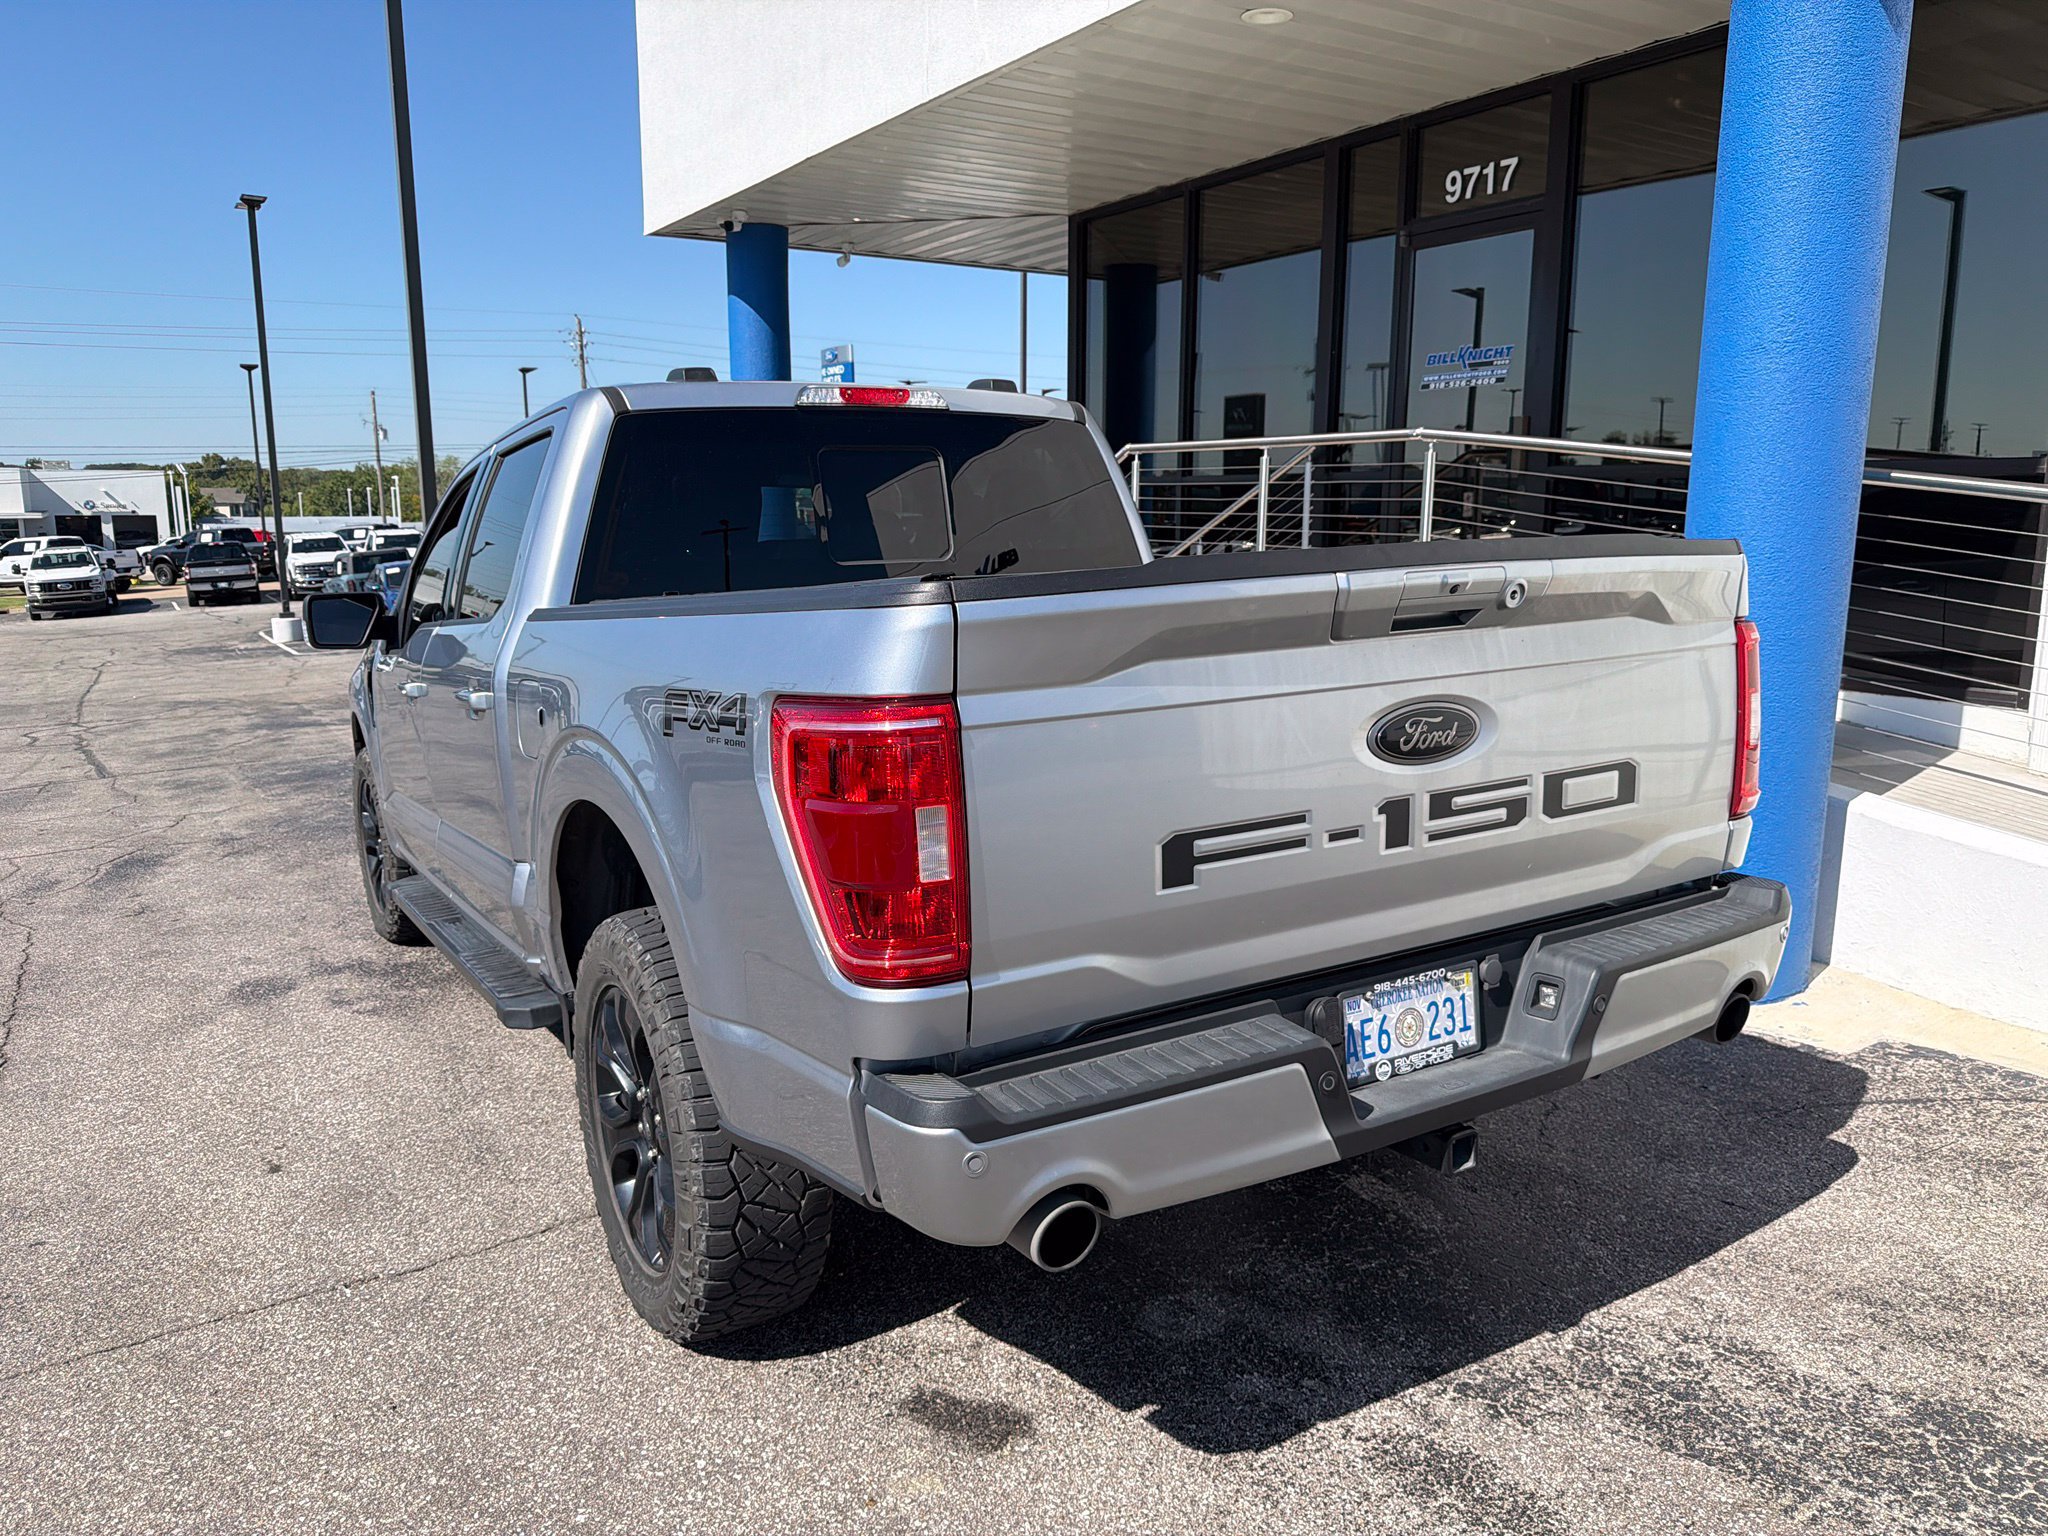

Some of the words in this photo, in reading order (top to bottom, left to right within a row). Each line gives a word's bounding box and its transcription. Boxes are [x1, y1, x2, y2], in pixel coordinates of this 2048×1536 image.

[1445, 156, 1519, 203] 9717
[663, 688, 747, 737] FX4
[706, 736, 721, 744] OFF
[724, 738, 746, 749] ROAD
[1400, 715, 1458, 752] Ford
[1158, 759, 1639, 893] F-150
[1374, 968, 1446, 993] 918-445-6700
[1346, 999, 1361, 1012] NOV
[1346, 1014, 1391, 1064] AE6
[1426, 993, 1471, 1041] 231
[1394, 1044, 1453, 1067] RIVERSIDE
[1427, 1053, 1454, 1066] TULSA
